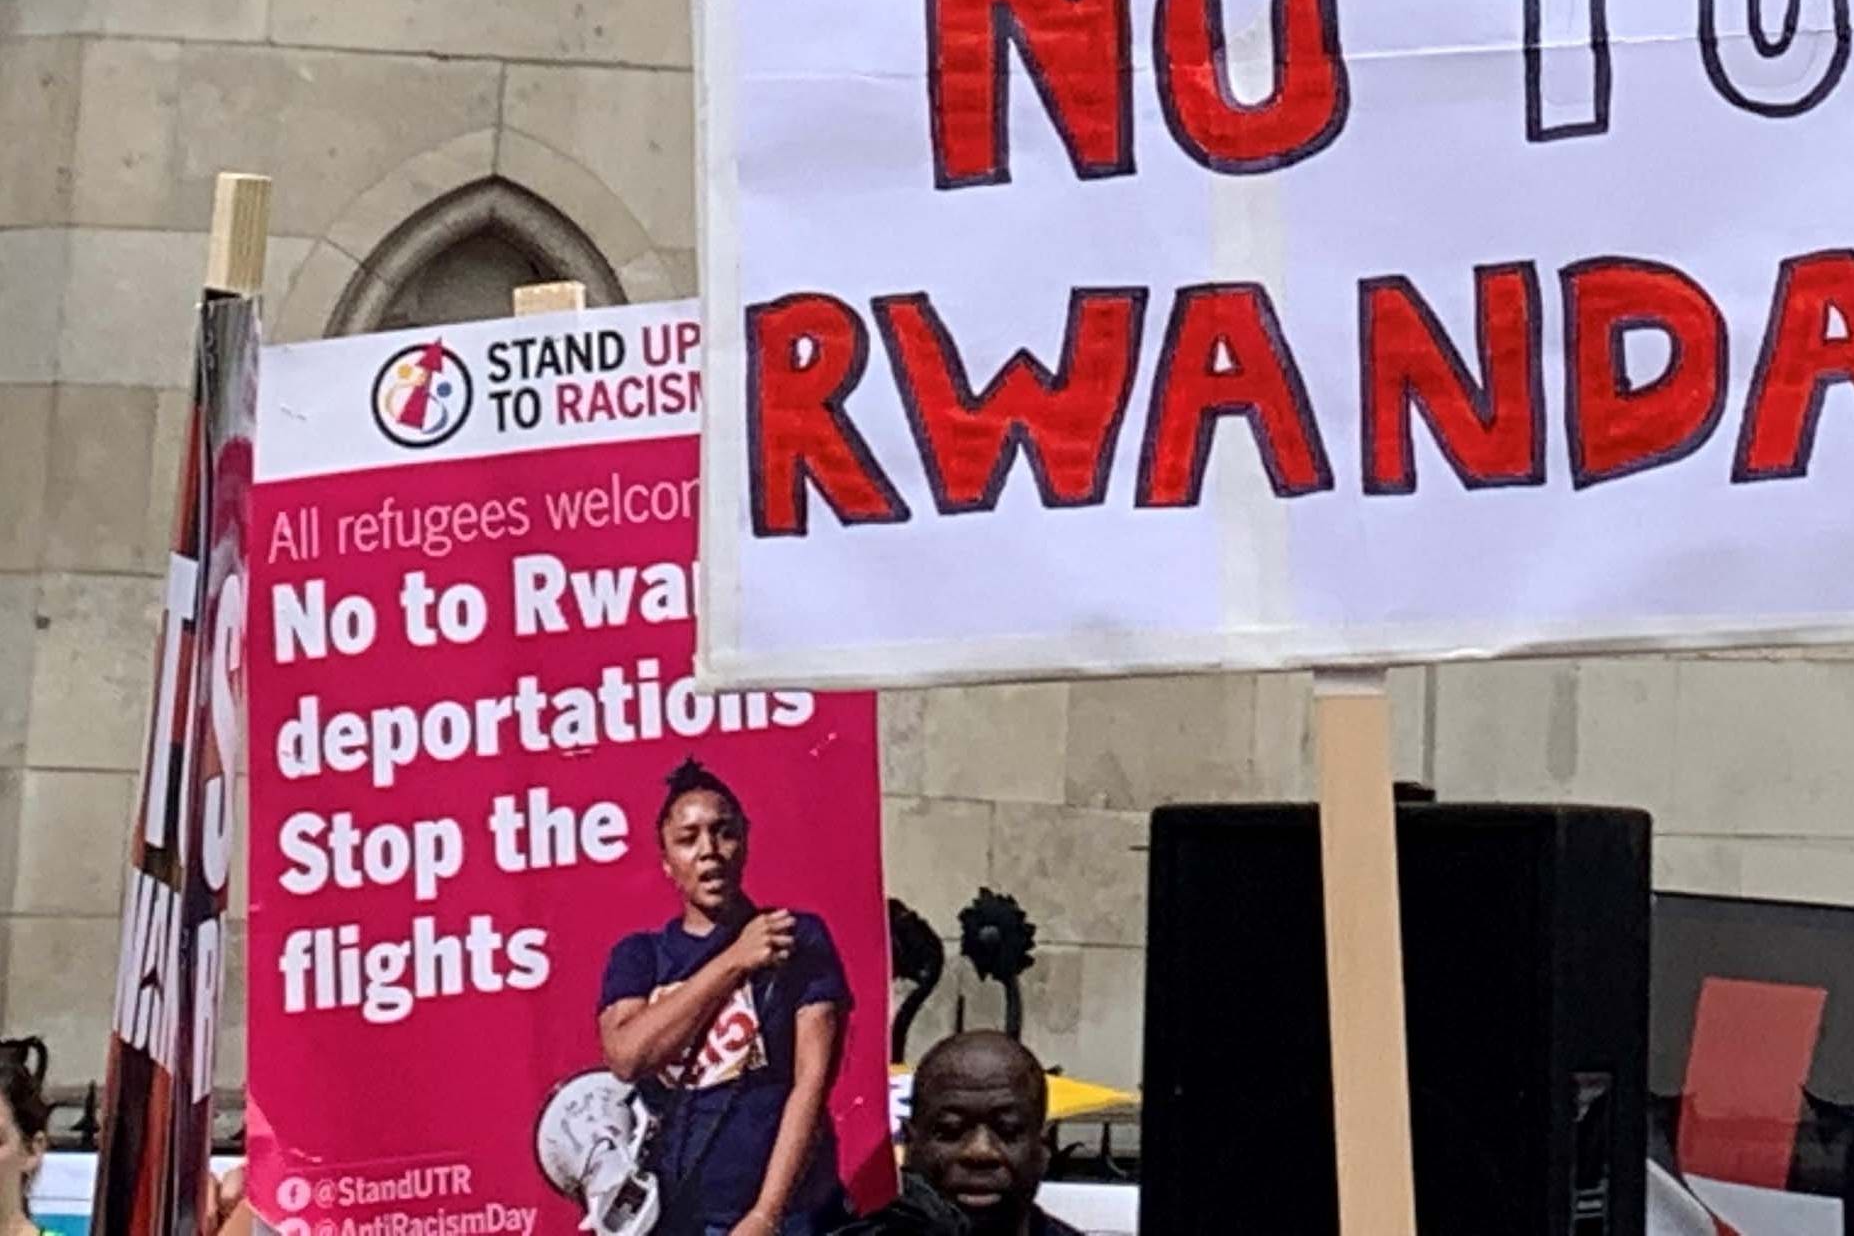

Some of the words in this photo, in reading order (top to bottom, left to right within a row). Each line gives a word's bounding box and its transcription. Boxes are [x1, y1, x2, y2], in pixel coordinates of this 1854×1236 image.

[488, 330, 626, 384] STAND
[642, 321, 700, 366] UP
[489, 389, 542, 433] TO
[268, 507, 320, 564] All
[338, 497, 530, 557] refugees
[272, 578, 376, 663] No
[401, 570, 487, 646] to
[514, 554, 700, 637] Rwa
[279, 811, 463, 900] Stop
[490, 787, 628, 872] the
[279, 915, 550, 1024] flights
[314, 1164, 472, 1207] @StandUTR
